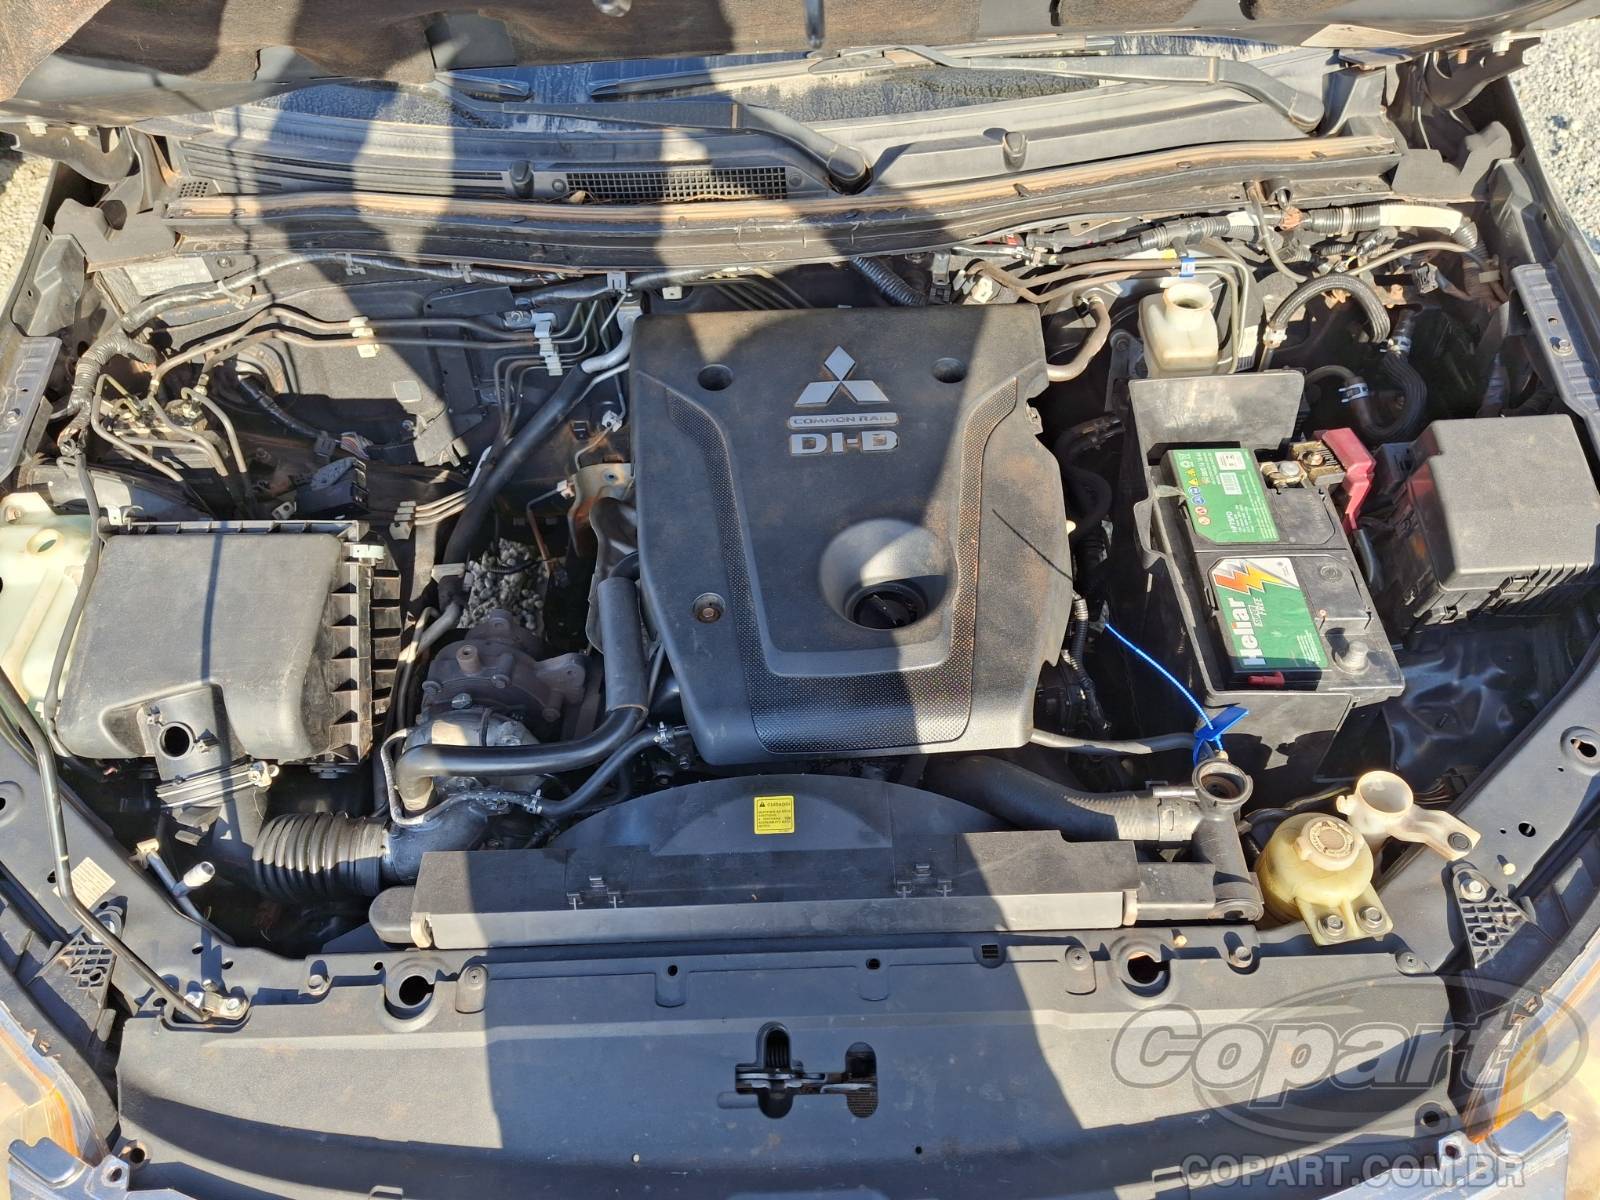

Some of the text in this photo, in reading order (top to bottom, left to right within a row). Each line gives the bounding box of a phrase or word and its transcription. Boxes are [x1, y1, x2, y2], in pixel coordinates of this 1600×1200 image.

[793, 415, 891, 425] COMMON RAIL
[790, 430, 899, 455] DI-D
[1227, 597, 1267, 666] Heliar
